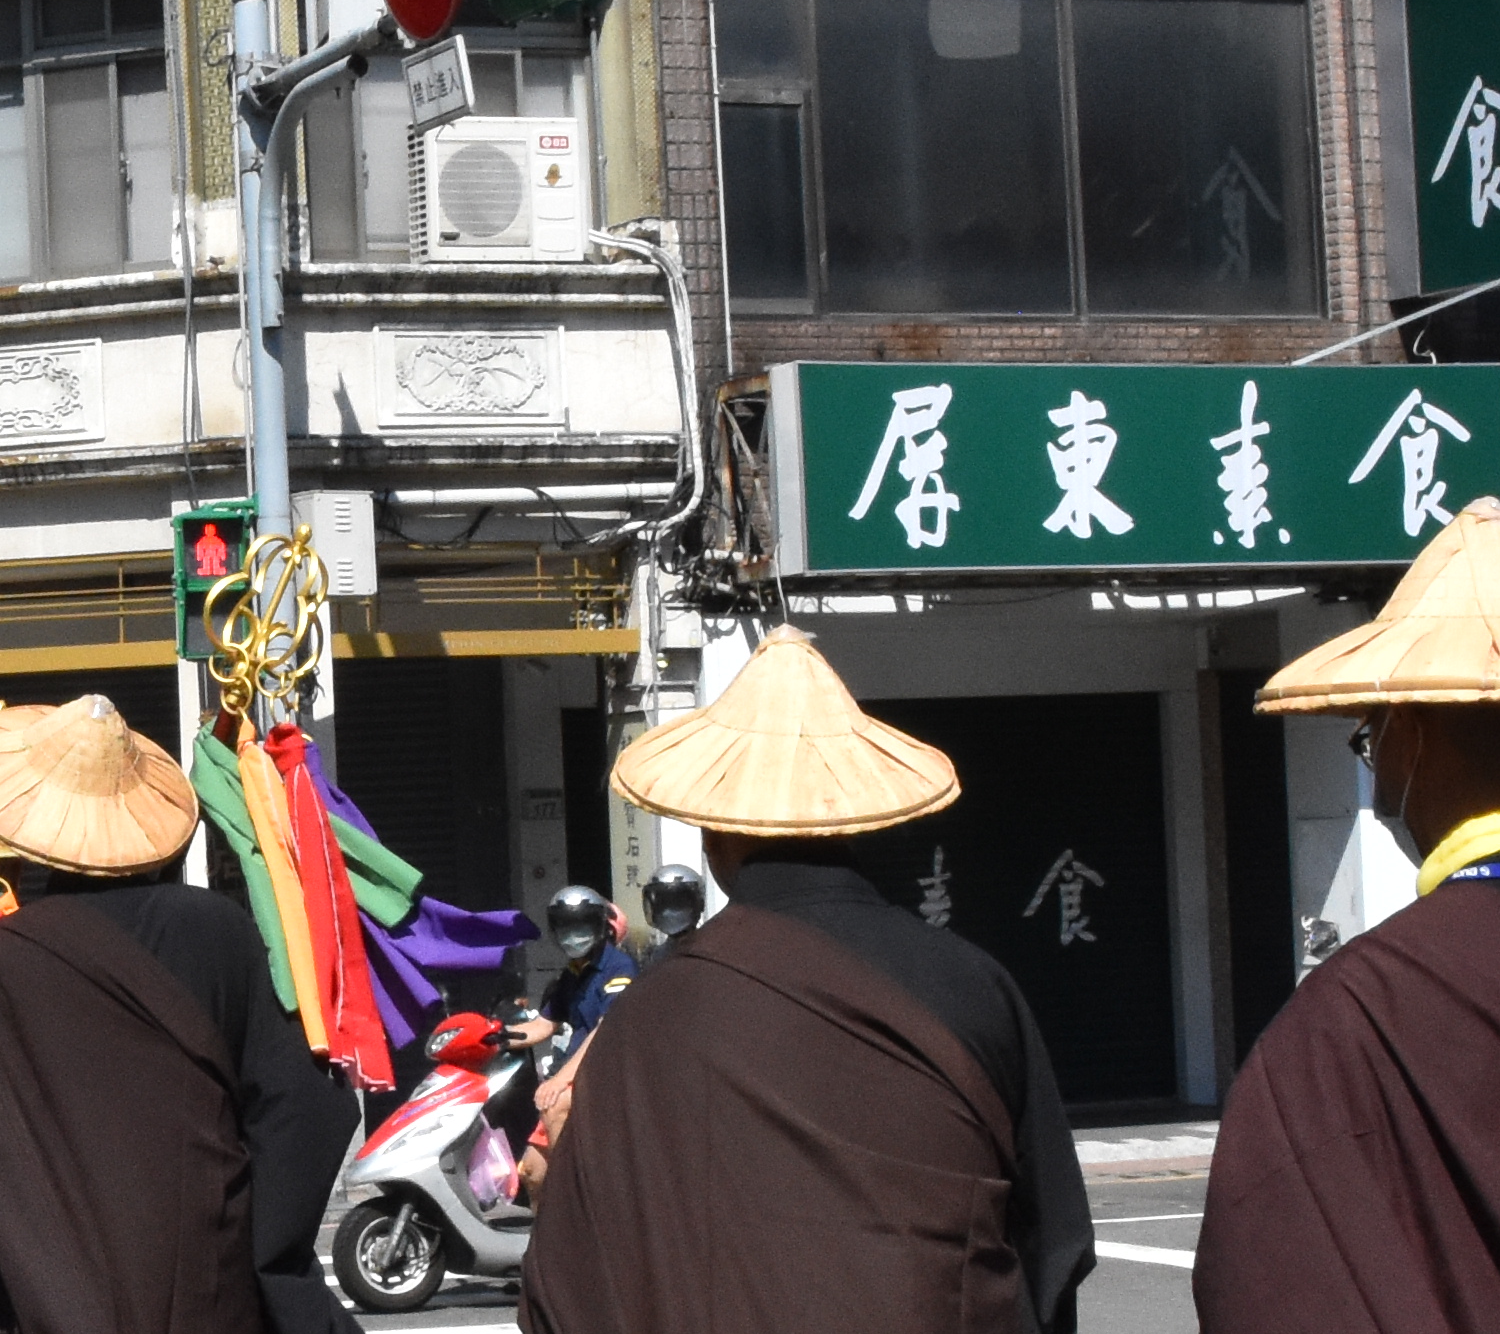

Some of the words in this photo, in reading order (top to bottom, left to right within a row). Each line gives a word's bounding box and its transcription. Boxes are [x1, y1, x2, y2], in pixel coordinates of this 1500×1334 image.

[412, 66, 461, 108] 禁止進入
[848, 378, 1471, 550] 屏東素食
